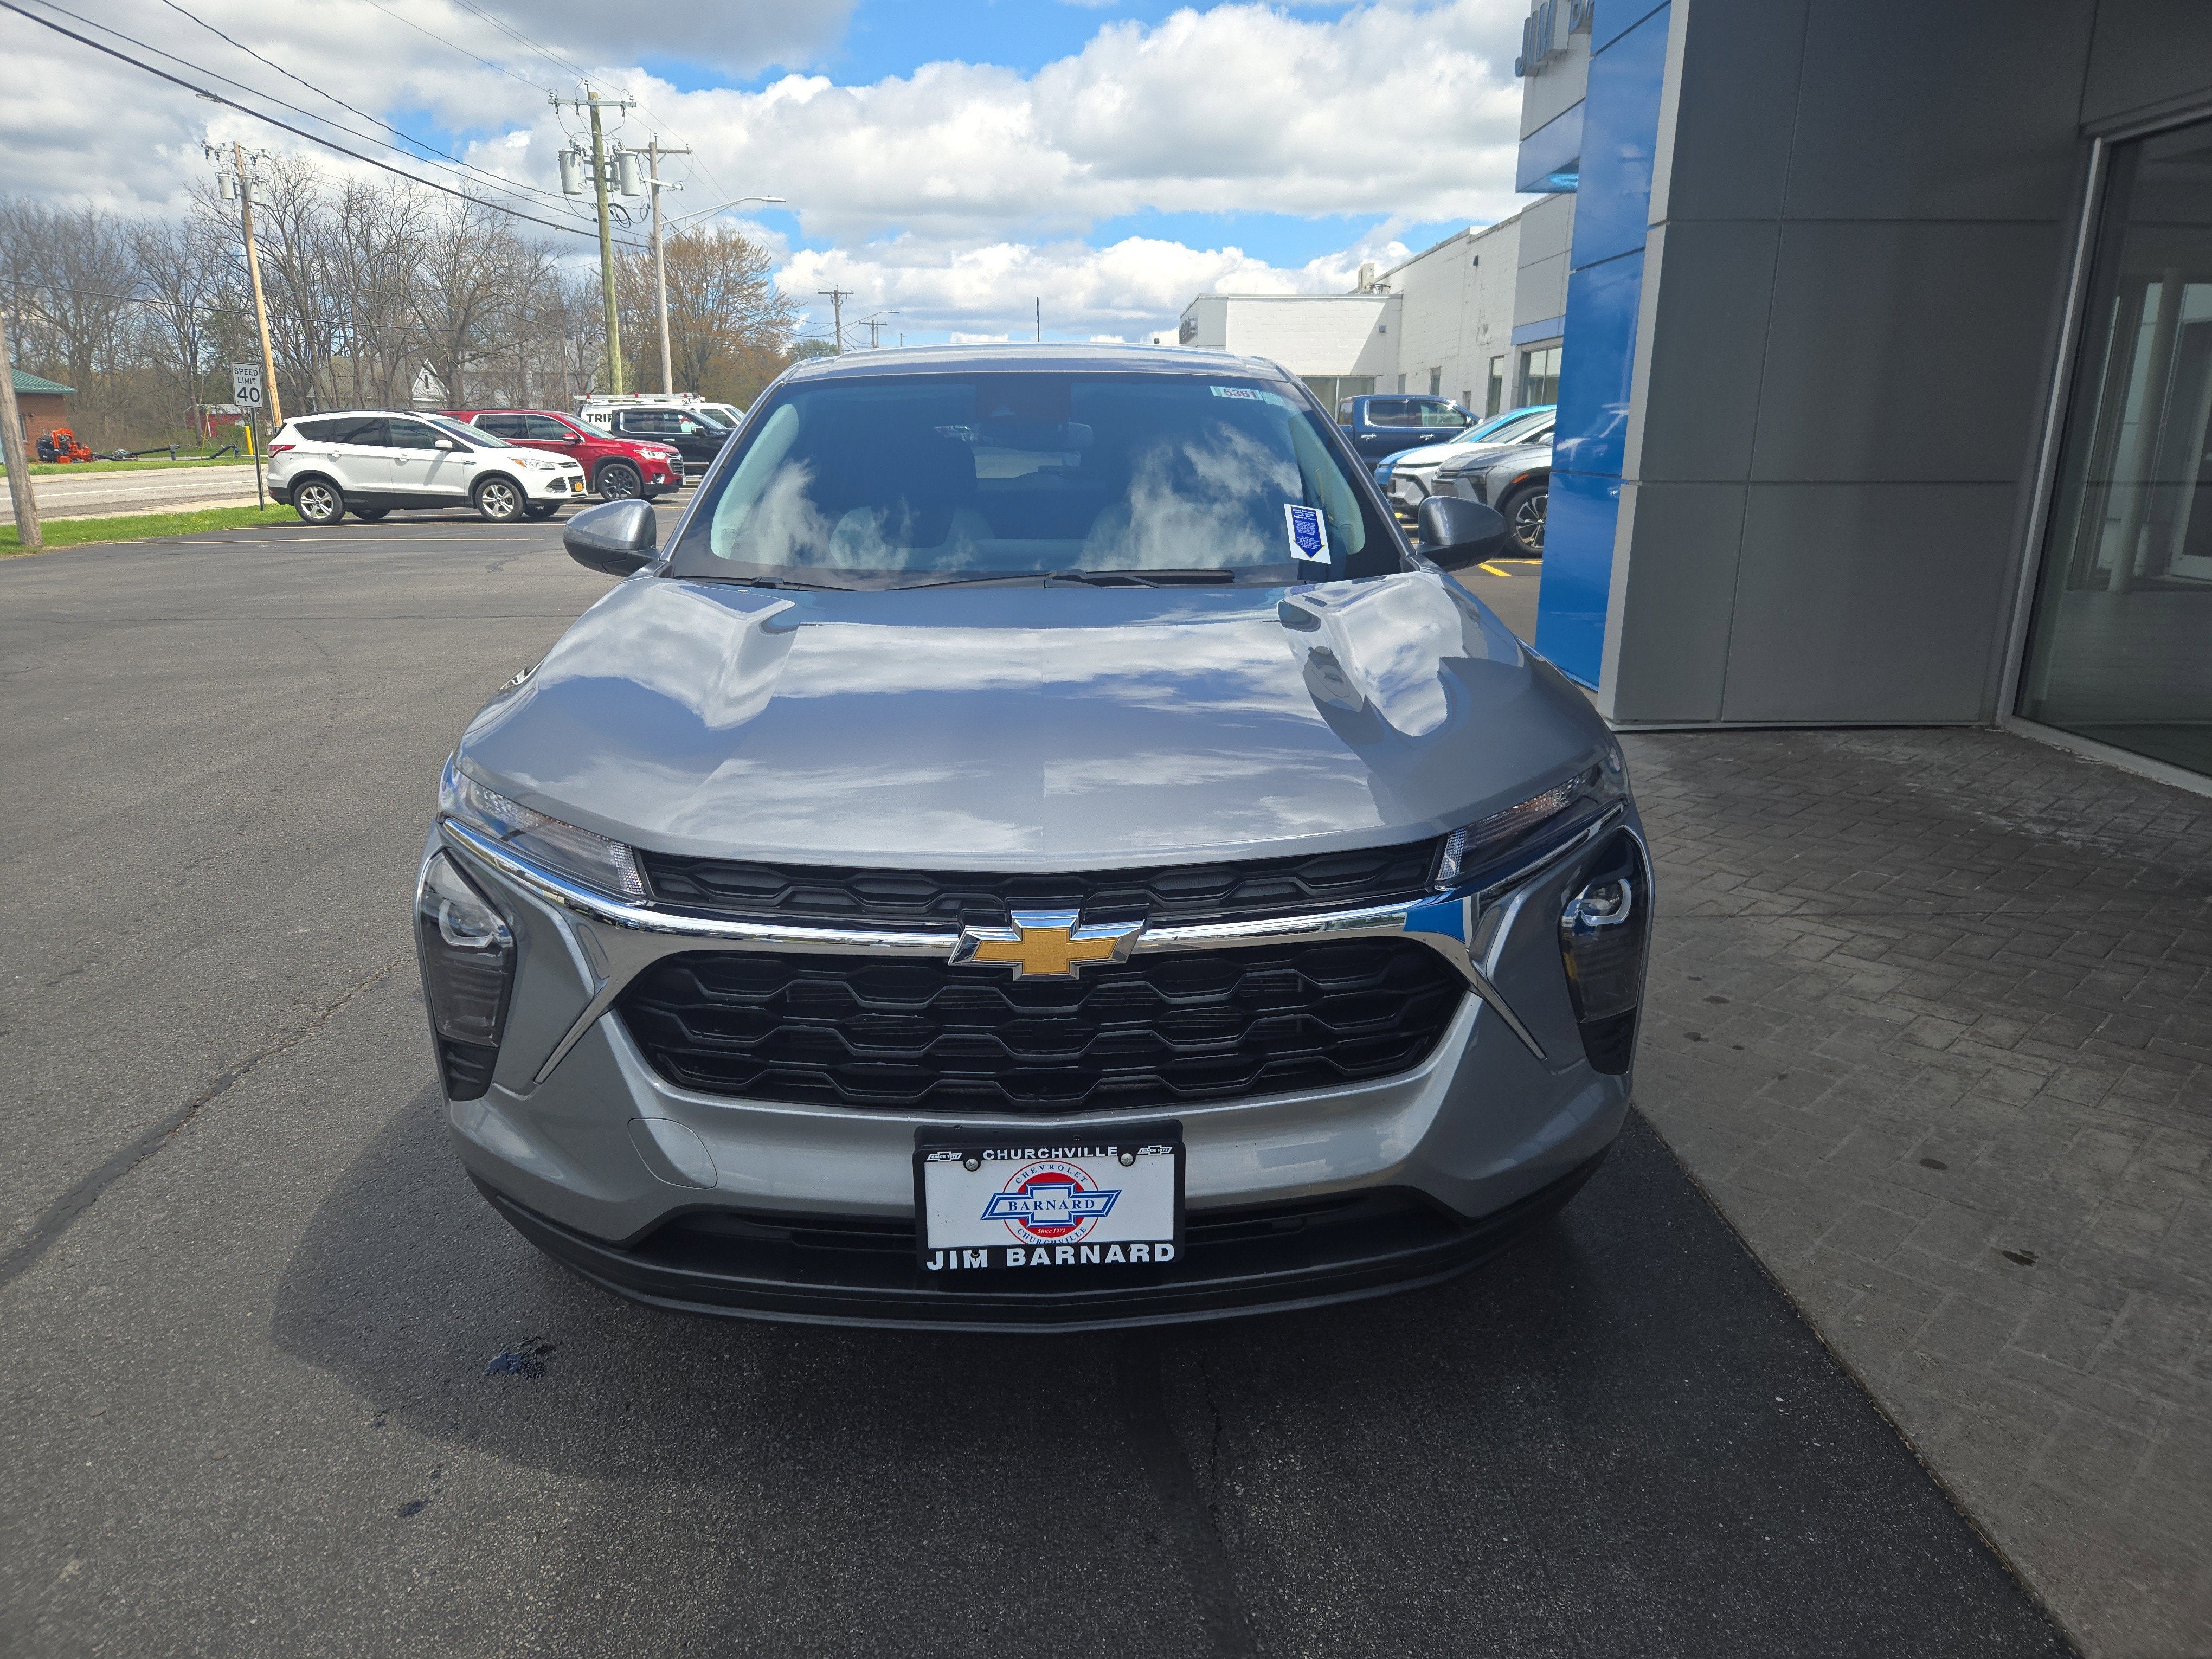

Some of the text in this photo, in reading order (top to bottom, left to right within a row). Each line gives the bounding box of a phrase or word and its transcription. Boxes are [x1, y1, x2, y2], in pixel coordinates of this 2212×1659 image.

[234, 368, 258, 376] SPEED
[237, 387, 260, 403] 40
[1223, 389, 1257, 398] 5361
[983, 1146, 1118, 1160] CHURCHVILLE
[1015, 1164, 1088, 1184] CHEVROLET
[1008, 1199, 1095, 1211] BARNARD
[927, 1243, 1175, 1270] JIM BARNARD
